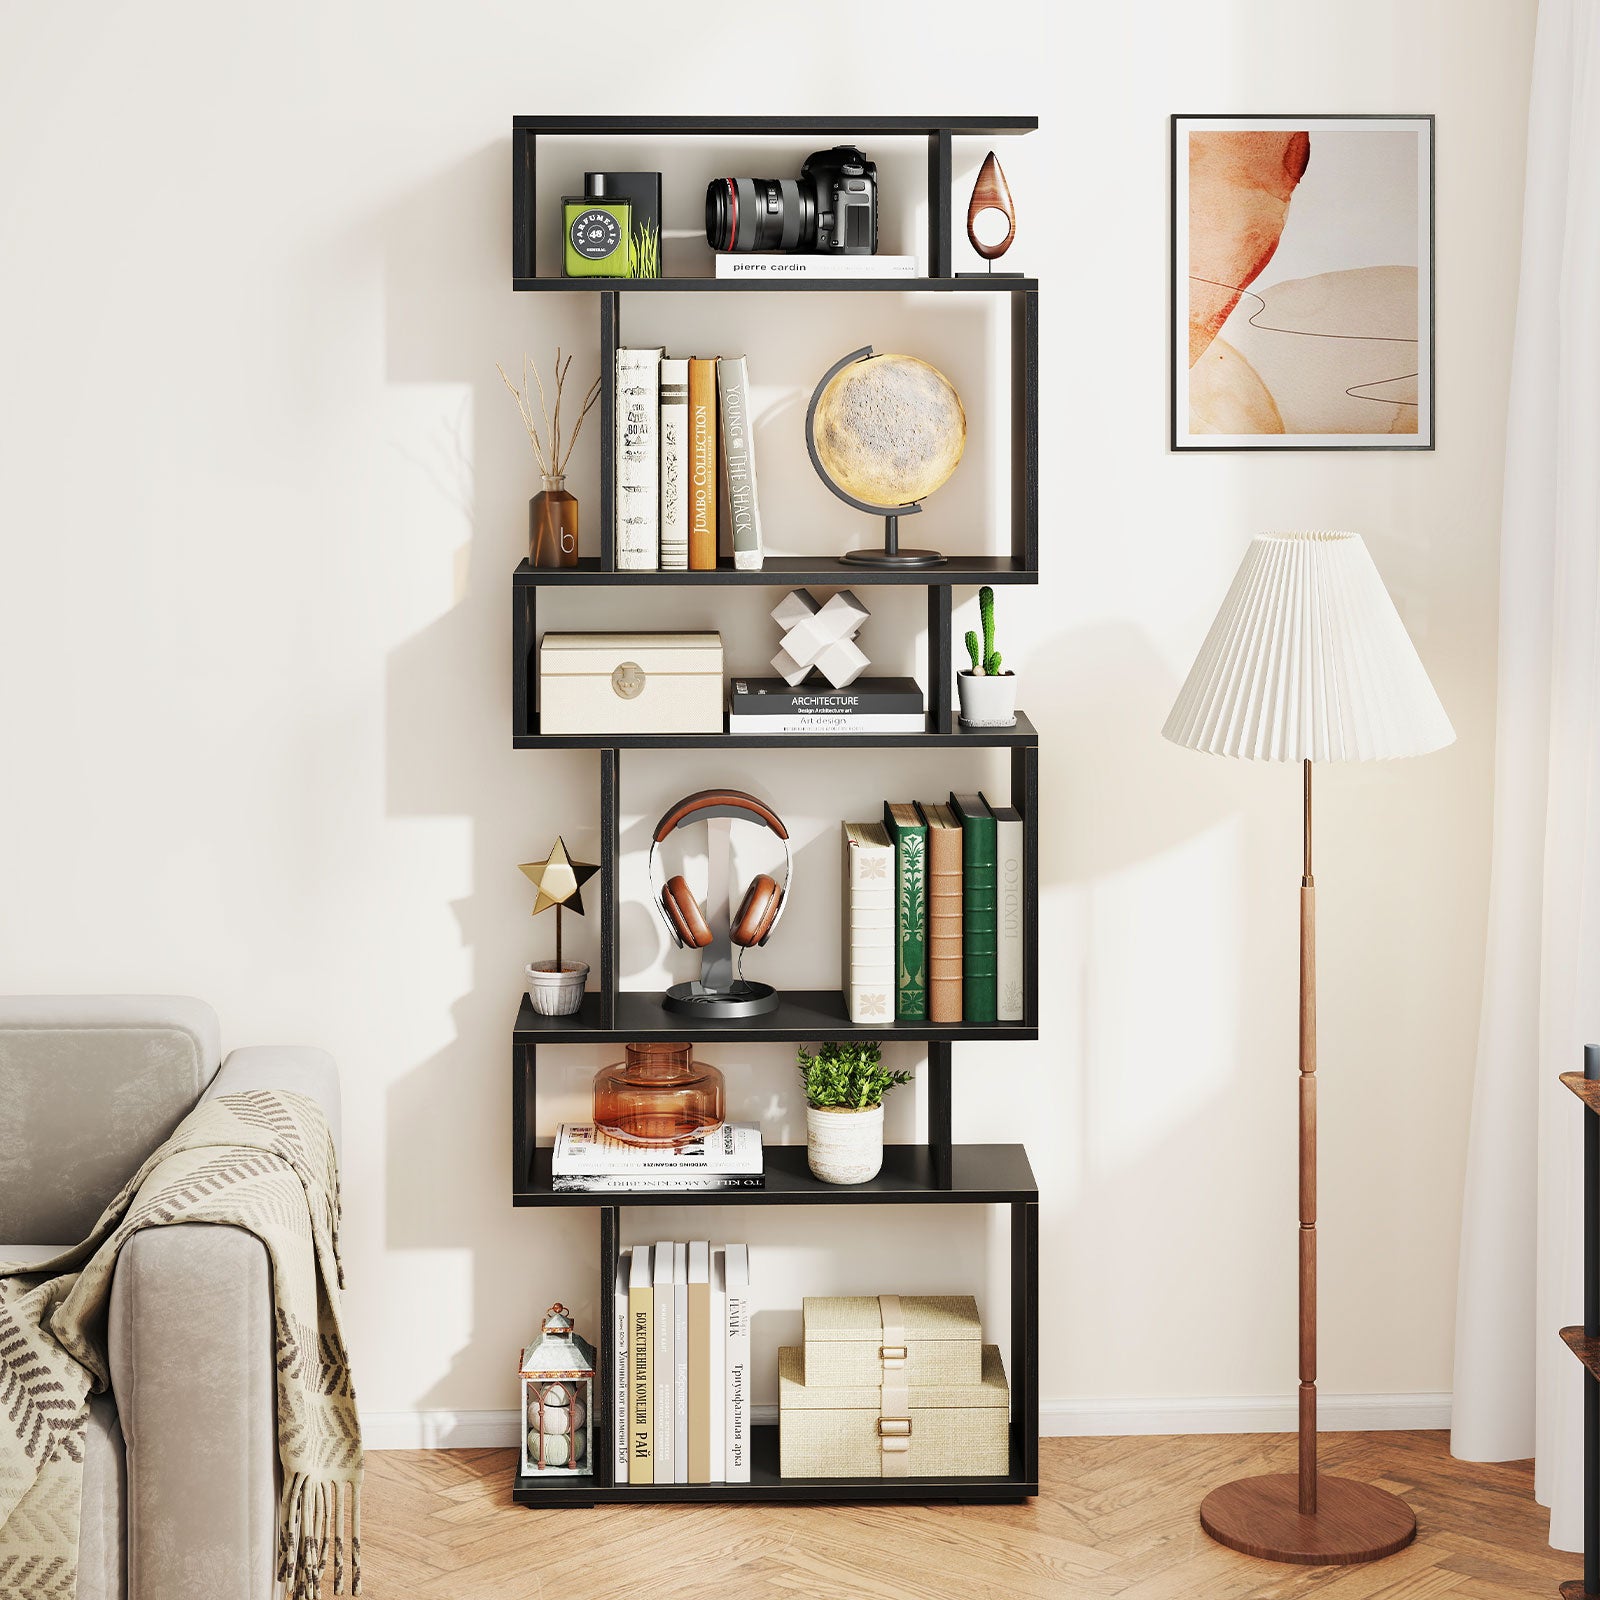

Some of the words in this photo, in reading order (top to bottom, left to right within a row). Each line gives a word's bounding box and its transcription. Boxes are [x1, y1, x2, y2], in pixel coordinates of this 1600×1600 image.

[577, 214, 616, 245] PARFUMERIE
[589, 230, 603, 239] 48
[733, 262, 767, 272] pierre
[770, 262, 807, 271] cardin
[725, 384, 743, 437] YOUNG
[693, 405, 707, 487] COLLECTION
[729, 449, 748, 481] THE
[693, 489, 710, 534] JUMBO
[732, 484, 752, 535] SHACK
[560, 526, 575, 554] b
[791, 696, 859, 706] ARCHITECTURE
[800, 717, 814, 725] Art
[816, 717, 847, 726] design
[1004, 858, 1018, 939] LUXDECO
[636, 1312, 647, 1381] БОЖЕСТВЕННАЯ
[618, 1350, 628, 1389] Уличный
[635, 1383, 647, 1425] КОМЕДИЯ
[732, 1363, 744, 1440] Триумфальная
[618, 1447, 628, 1464] Боб
[635, 1432, 651, 1458] РАЙ
[732, 1443, 742, 1467] арка
